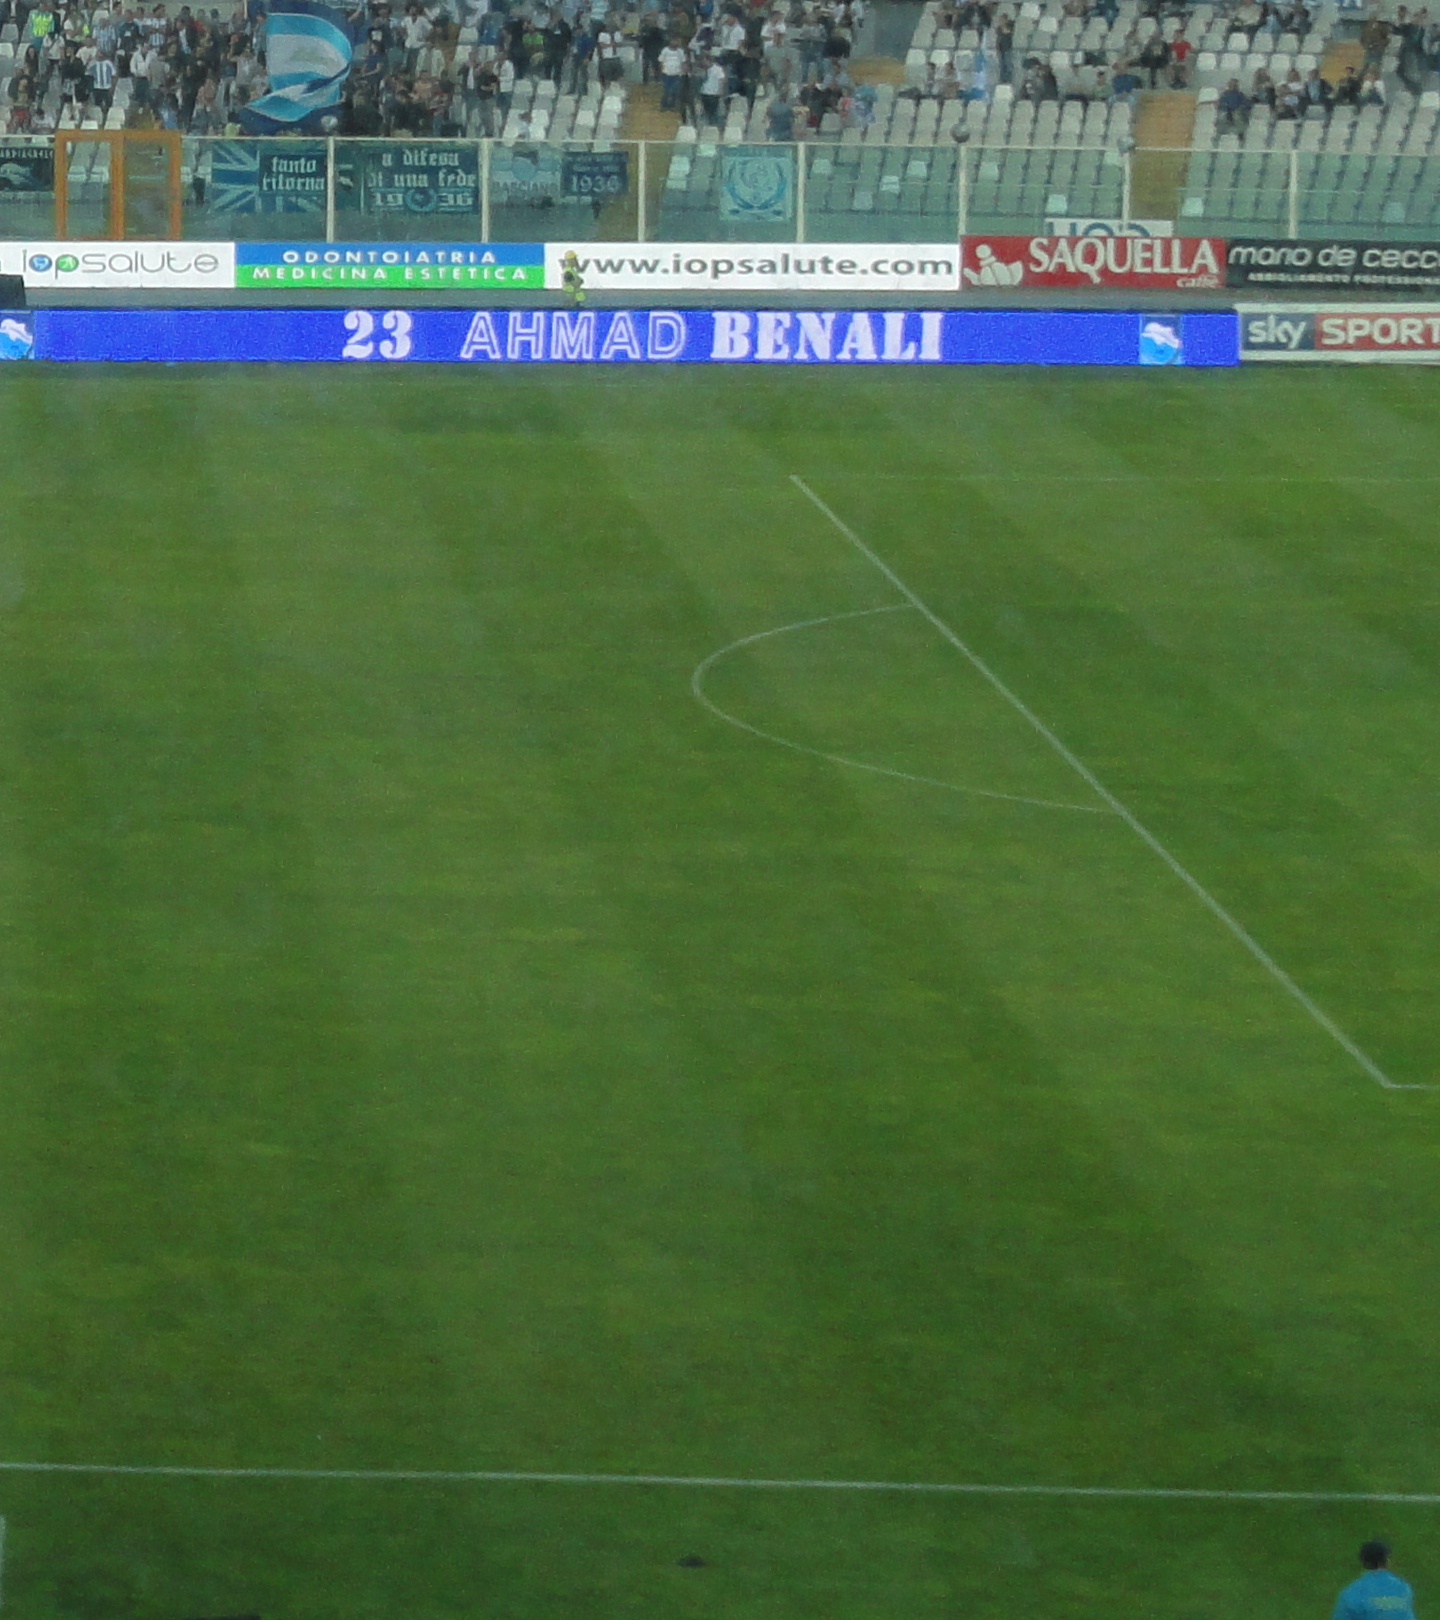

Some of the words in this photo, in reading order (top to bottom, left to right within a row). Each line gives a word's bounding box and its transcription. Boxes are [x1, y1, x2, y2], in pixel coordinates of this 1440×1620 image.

[22, 249, 219, 279] iopsalute
[282, 251, 496, 264] ODONTOIATRIA
[1029, 237, 1220, 284] SAQUELLA
[1317, 245, 1358, 267] de
[1363, 249, 1440, 269] cecc
[253, 267, 386, 280] MEDICINA
[405, 267, 527, 281] ESTETICA
[343, 311, 412, 359] 23
[461, 311, 687, 360] AHMAD
[711, 311, 943, 361] BENALI
[1248, 314, 1306, 349] sky
